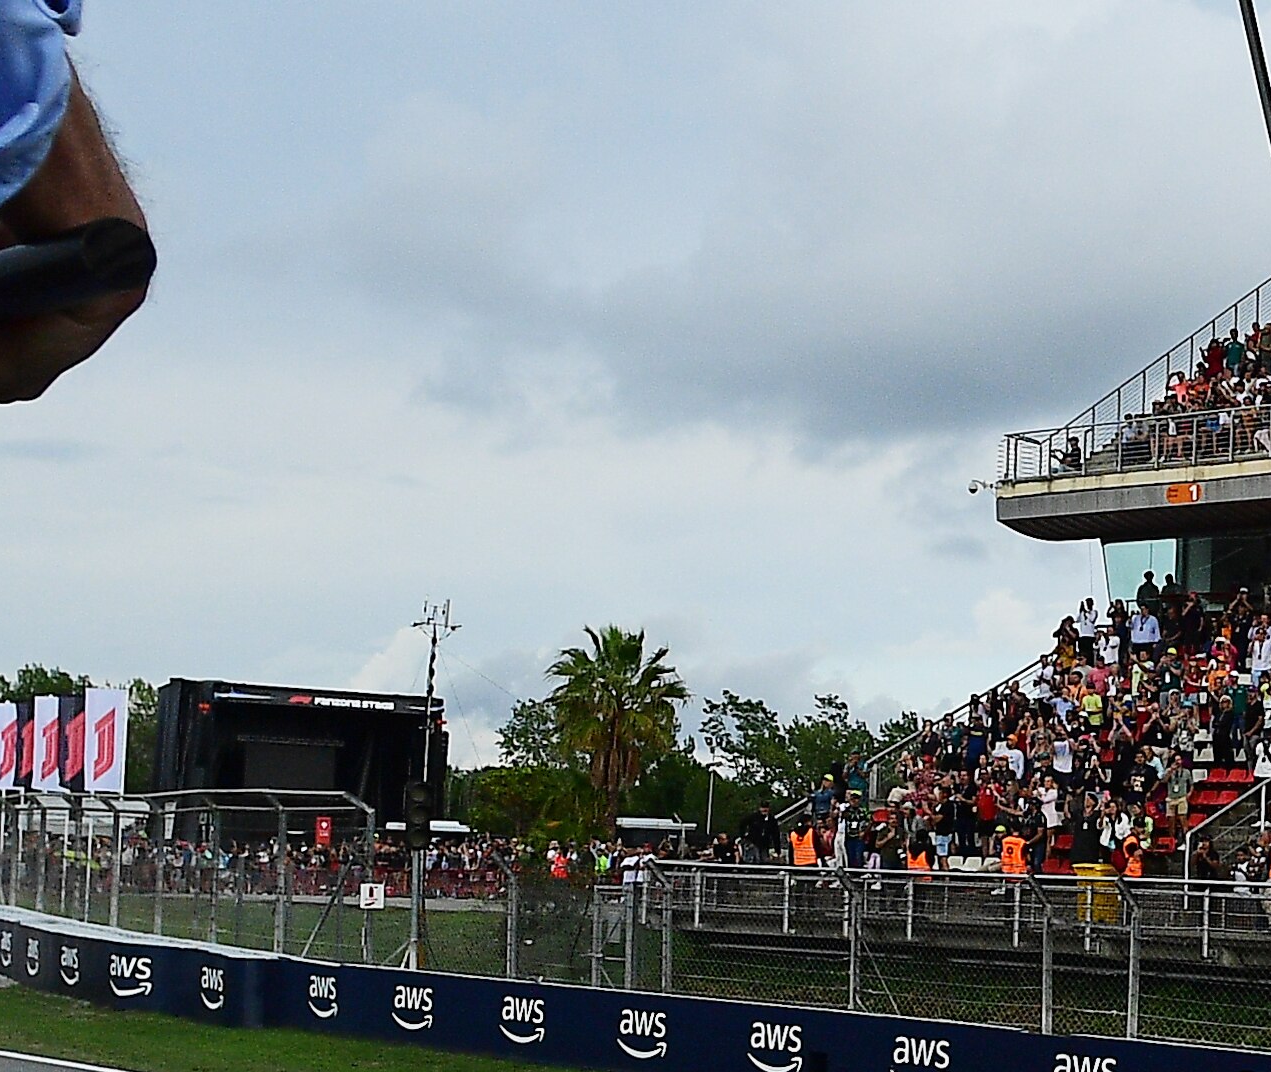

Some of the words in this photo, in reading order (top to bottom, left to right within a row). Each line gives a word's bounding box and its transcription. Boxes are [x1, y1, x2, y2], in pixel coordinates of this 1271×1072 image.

[1189, 485, 1198, 501] 1
[61, 946, 78, 968] aws
[110, 954, 151, 979] aws
[201, 966, 223, 991] aws
[310, 974, 336, 999] aws
[394, 985, 432, 1011] aws
[501, 996, 544, 1023] aws
[619, 1009, 666, 1038] aws
[750, 1021, 802, 1053] aws
[893, 1036, 950, 1068] aws
